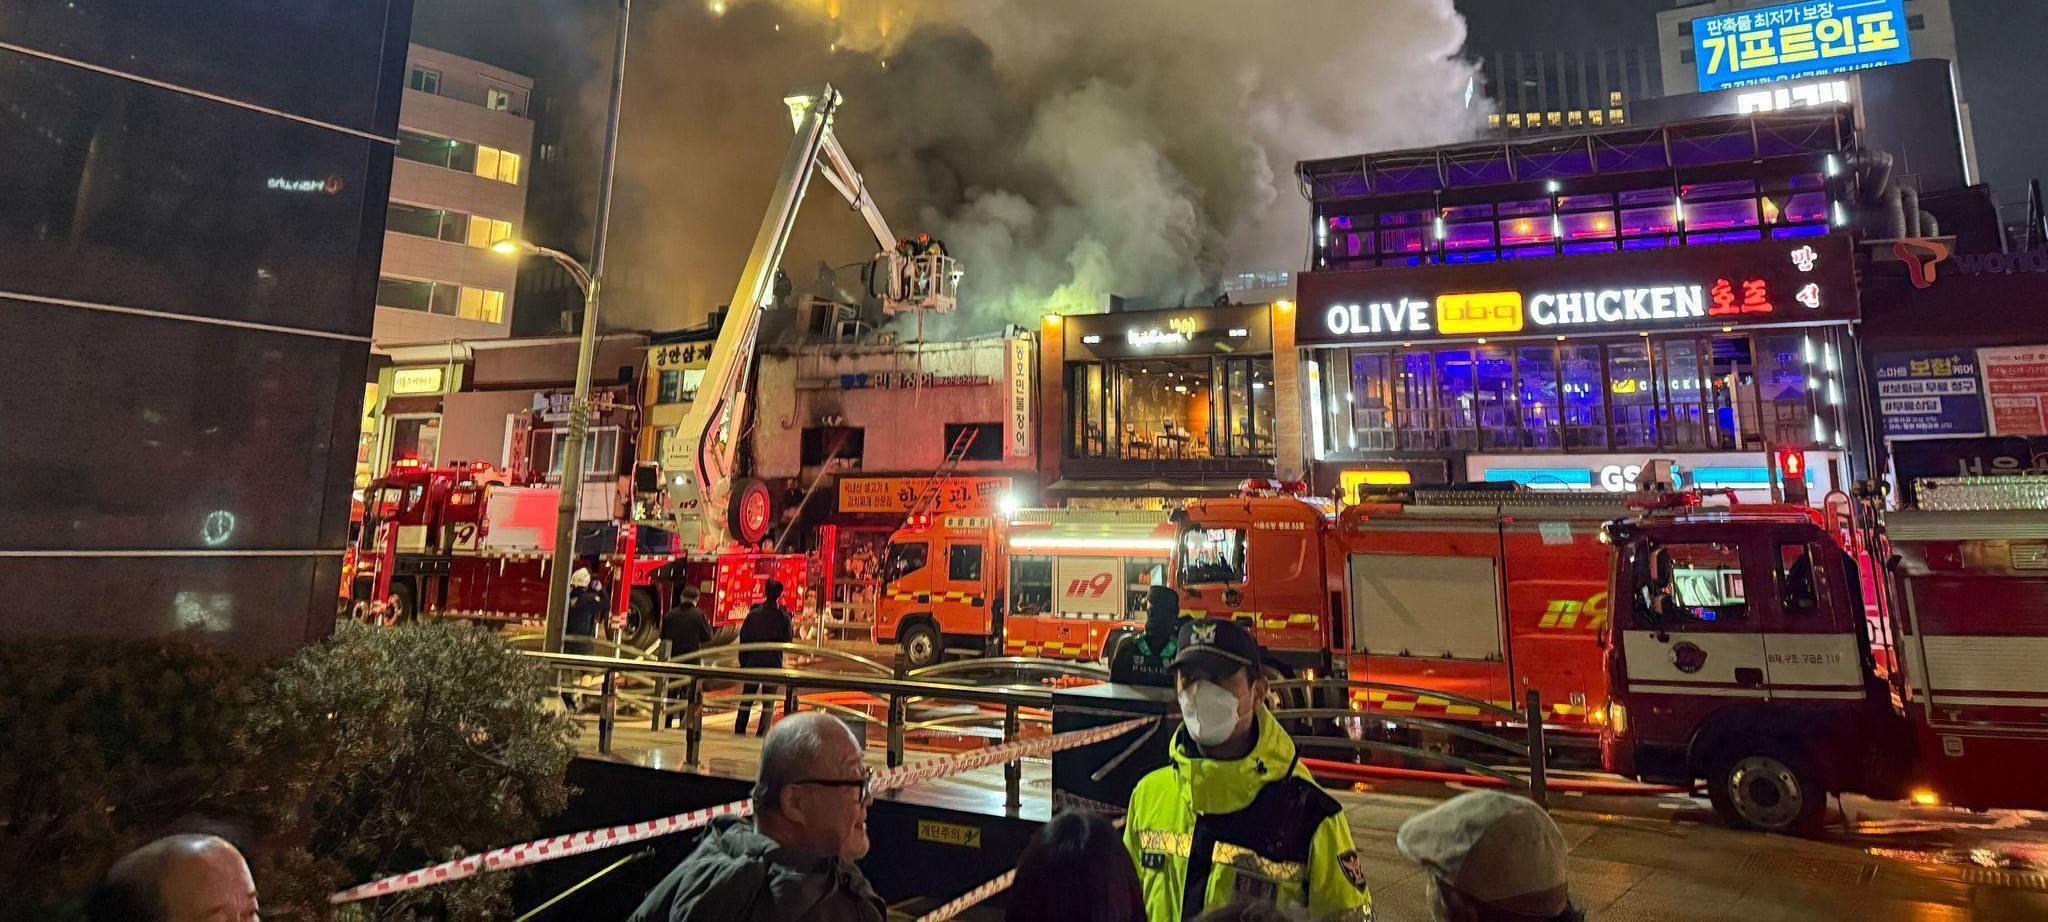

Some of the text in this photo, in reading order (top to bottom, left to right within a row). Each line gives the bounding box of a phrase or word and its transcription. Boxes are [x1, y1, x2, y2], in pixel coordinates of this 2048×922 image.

[1707, 2, 1834, 36] 판촉물 최저가 보장
[1702, 11, 1900, 75] 기프트인포
[1327, 297, 1430, 335] OLIVE
[1530, 285, 1705, 326] CHICKEN
[1708, 278, 1773, 315] 호프
[679, 499, 699, 510] 119
[1065, 571, 1113, 598] 119
[920, 823, 961, 840] 계단주의
